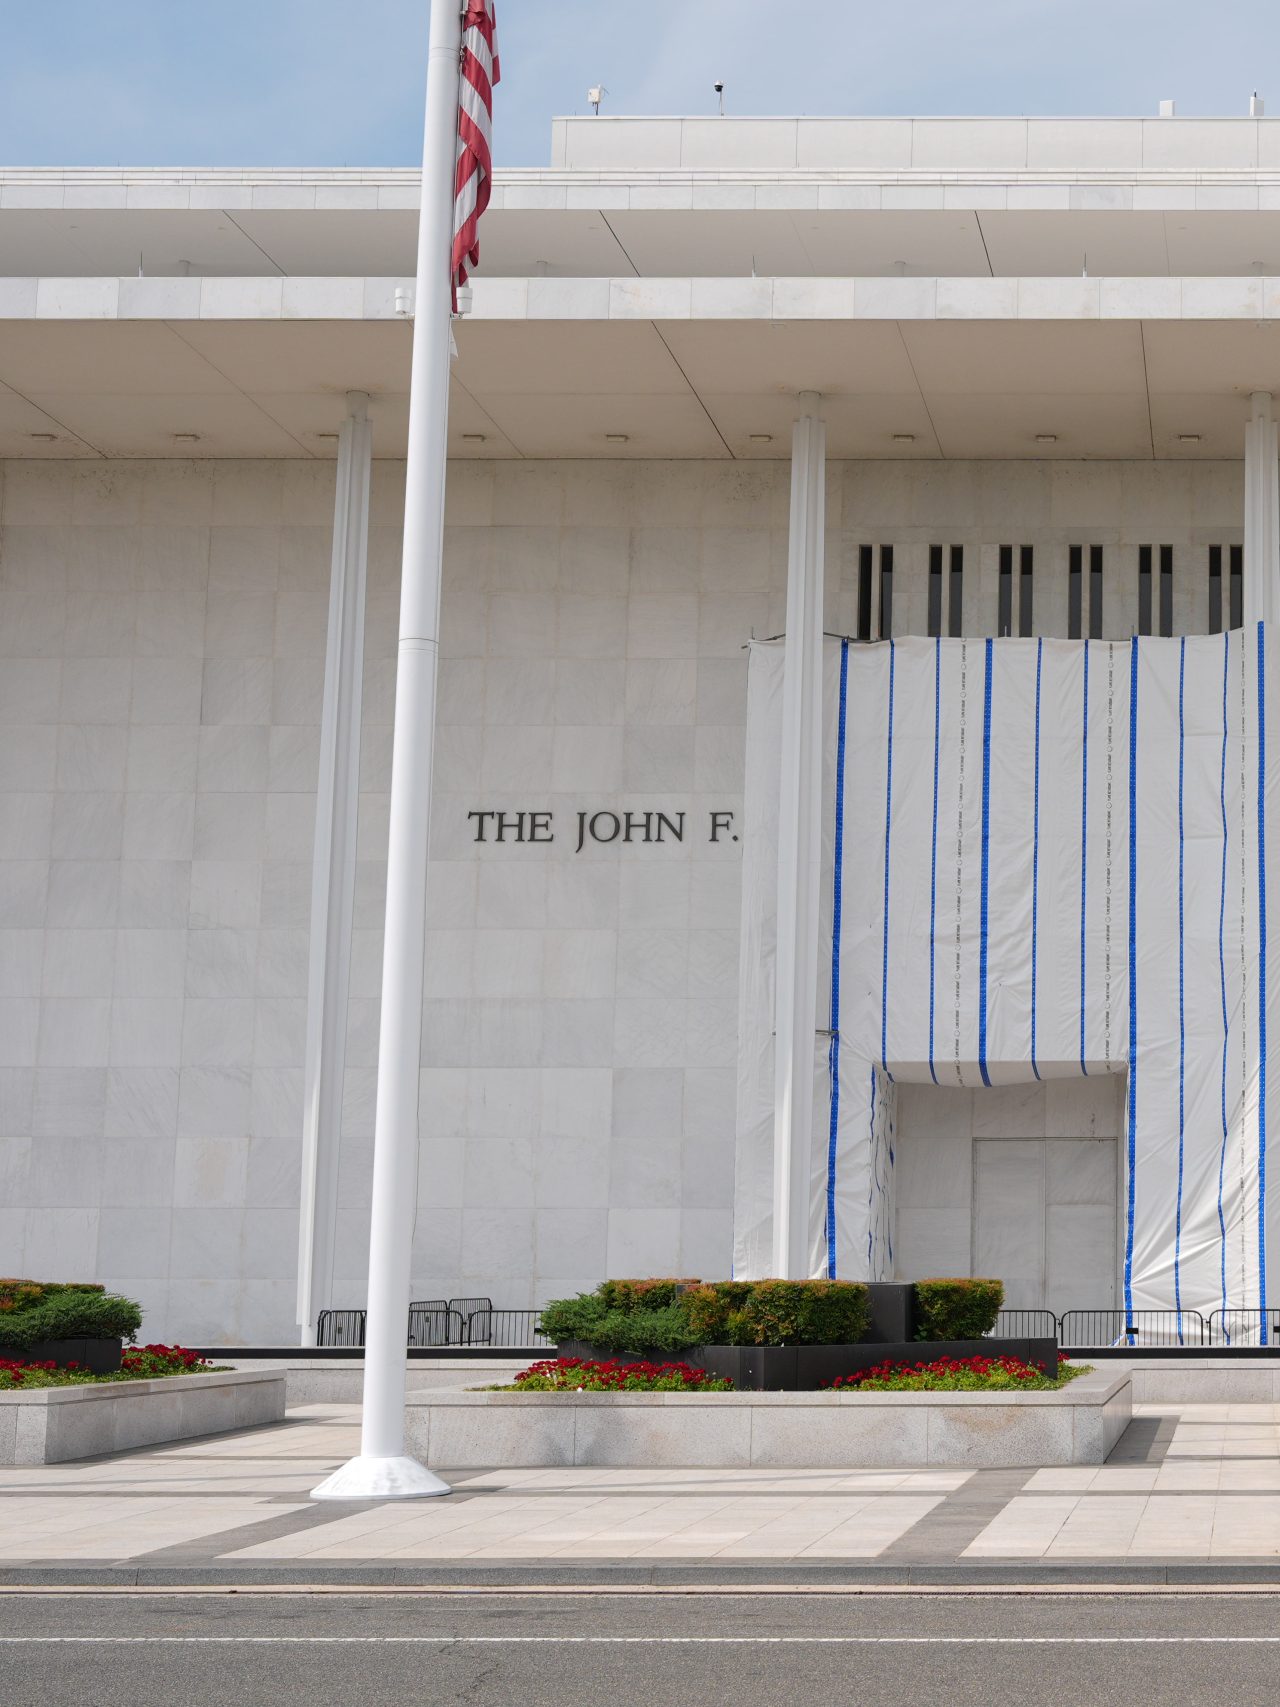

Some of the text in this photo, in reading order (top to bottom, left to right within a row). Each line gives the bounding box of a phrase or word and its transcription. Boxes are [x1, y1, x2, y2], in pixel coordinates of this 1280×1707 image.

[467, 811, 739, 853] THE JOHN F.
